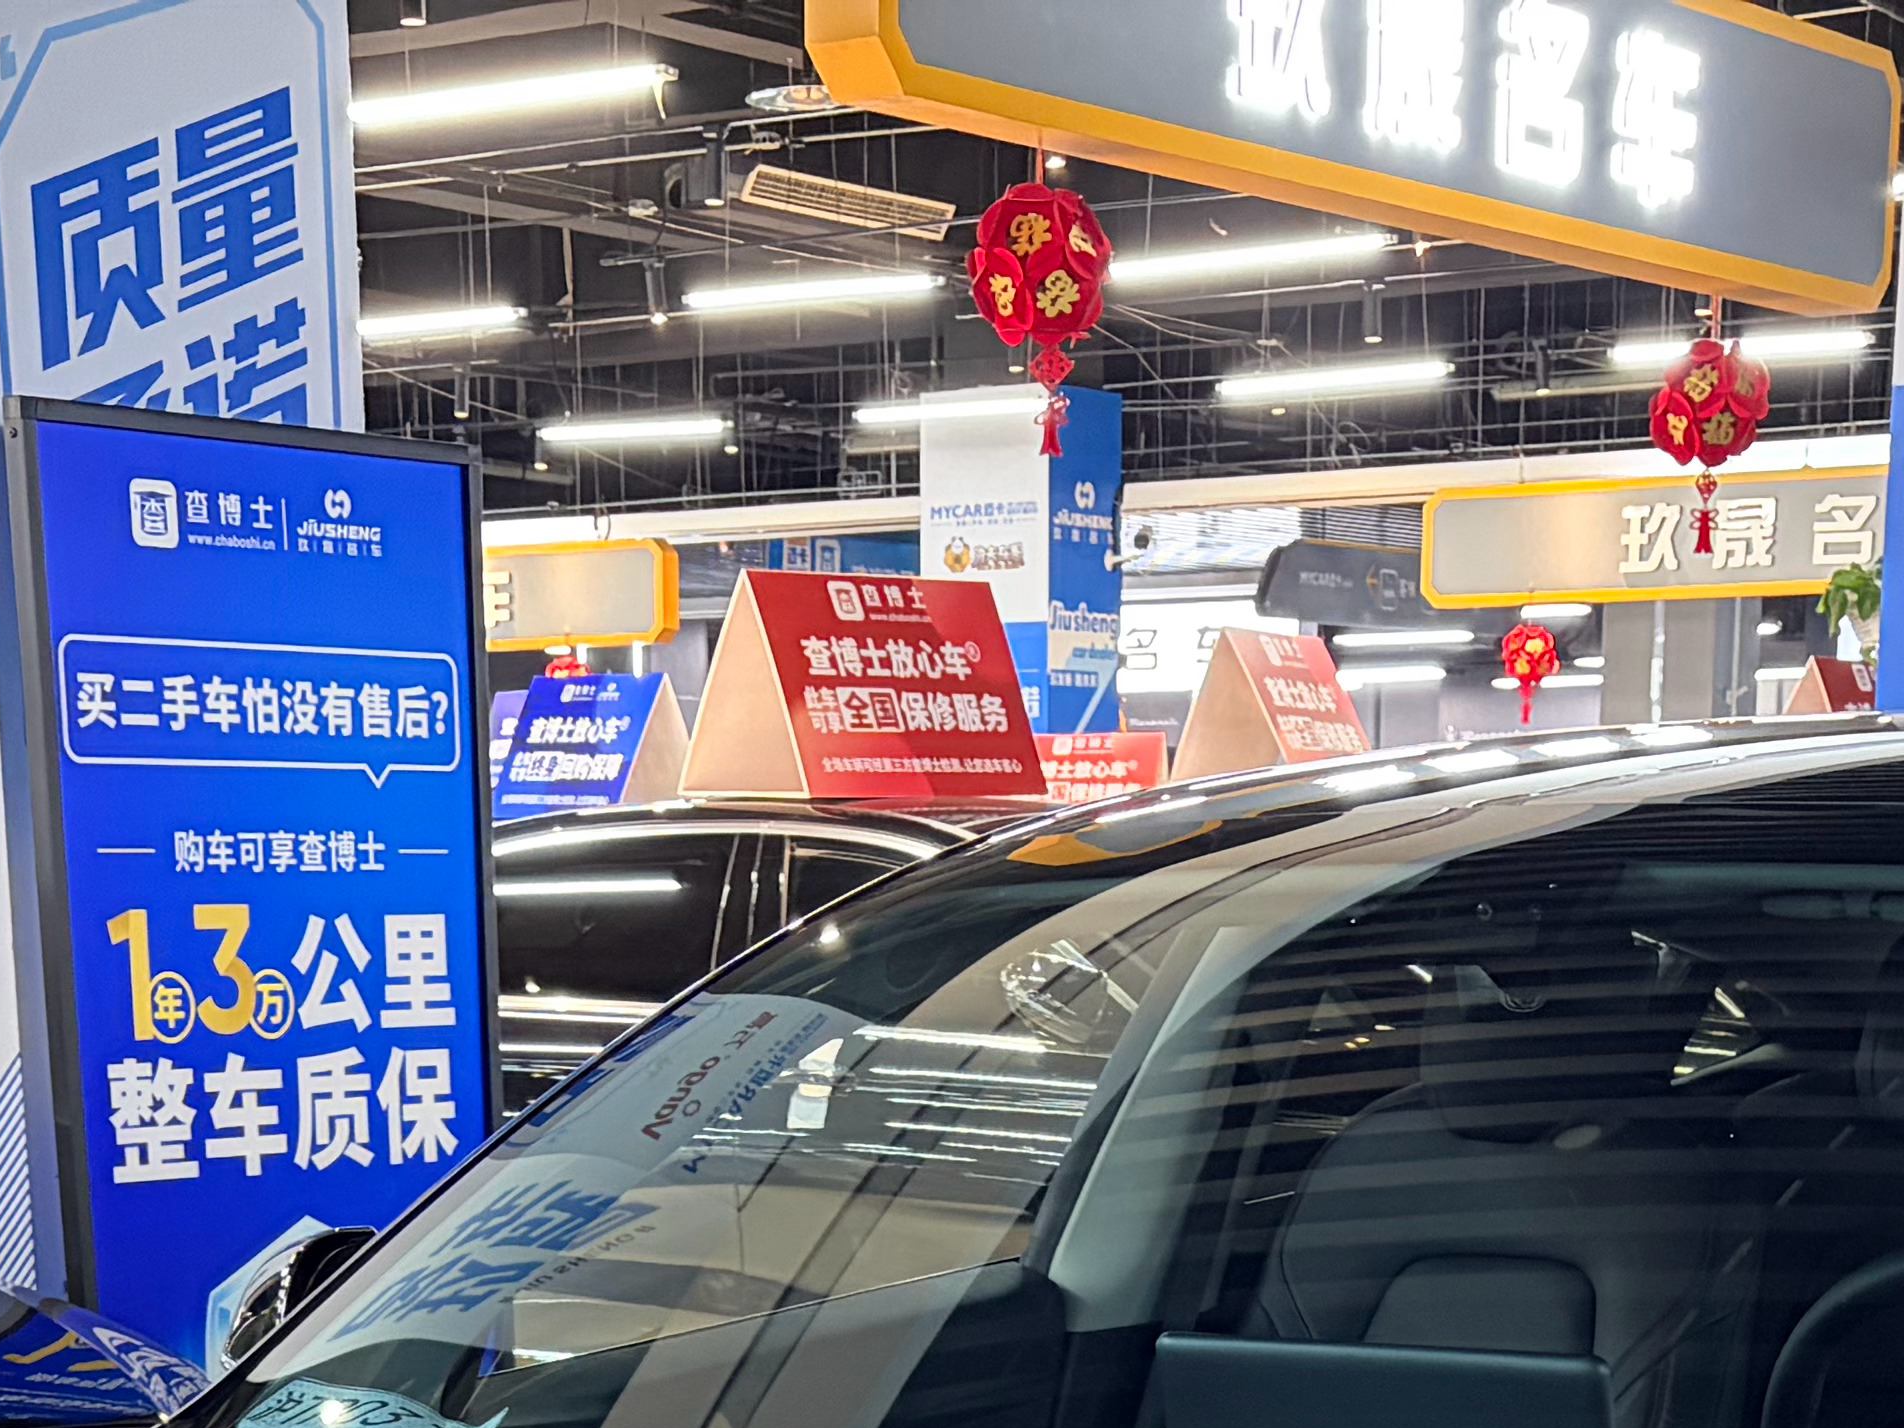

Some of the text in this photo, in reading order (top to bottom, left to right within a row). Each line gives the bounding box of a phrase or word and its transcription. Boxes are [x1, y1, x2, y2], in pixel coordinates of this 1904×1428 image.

[30, 86, 305, 372] 质量
[185, 490, 274, 530] 查博士
[800, 635, 972, 680] 查博士放心车
[75, 672, 448, 739] 买二手车怕没有售后?
[173, 831, 386, 874] 购车可享查博士
[107, 1047, 458, 1186] 整车质保
